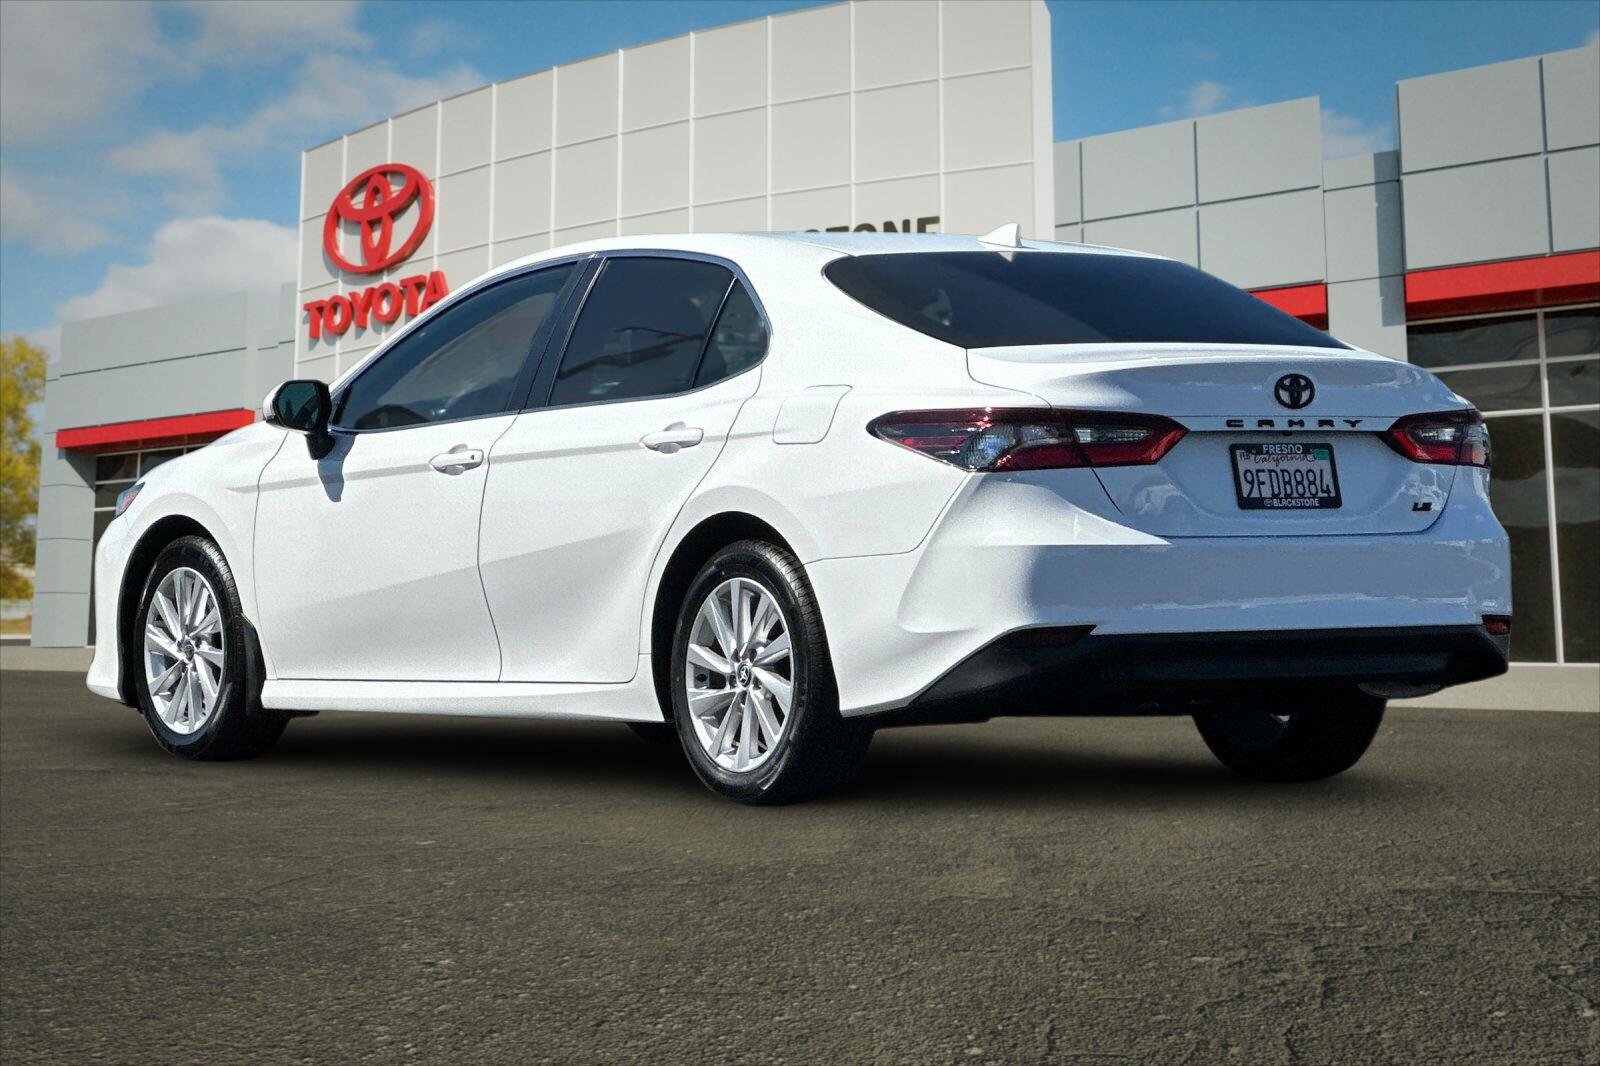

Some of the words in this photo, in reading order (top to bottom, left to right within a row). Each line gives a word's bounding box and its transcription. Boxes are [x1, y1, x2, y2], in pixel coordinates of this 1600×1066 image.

[303, 270, 449, 339] TOYOTA
[1226, 418, 1363, 428] CAMRY
[1262, 444, 1303, 454] FRESNO
[1243, 468, 1332, 498] 9FDB884
[1412, 502, 1433, 511] LE
